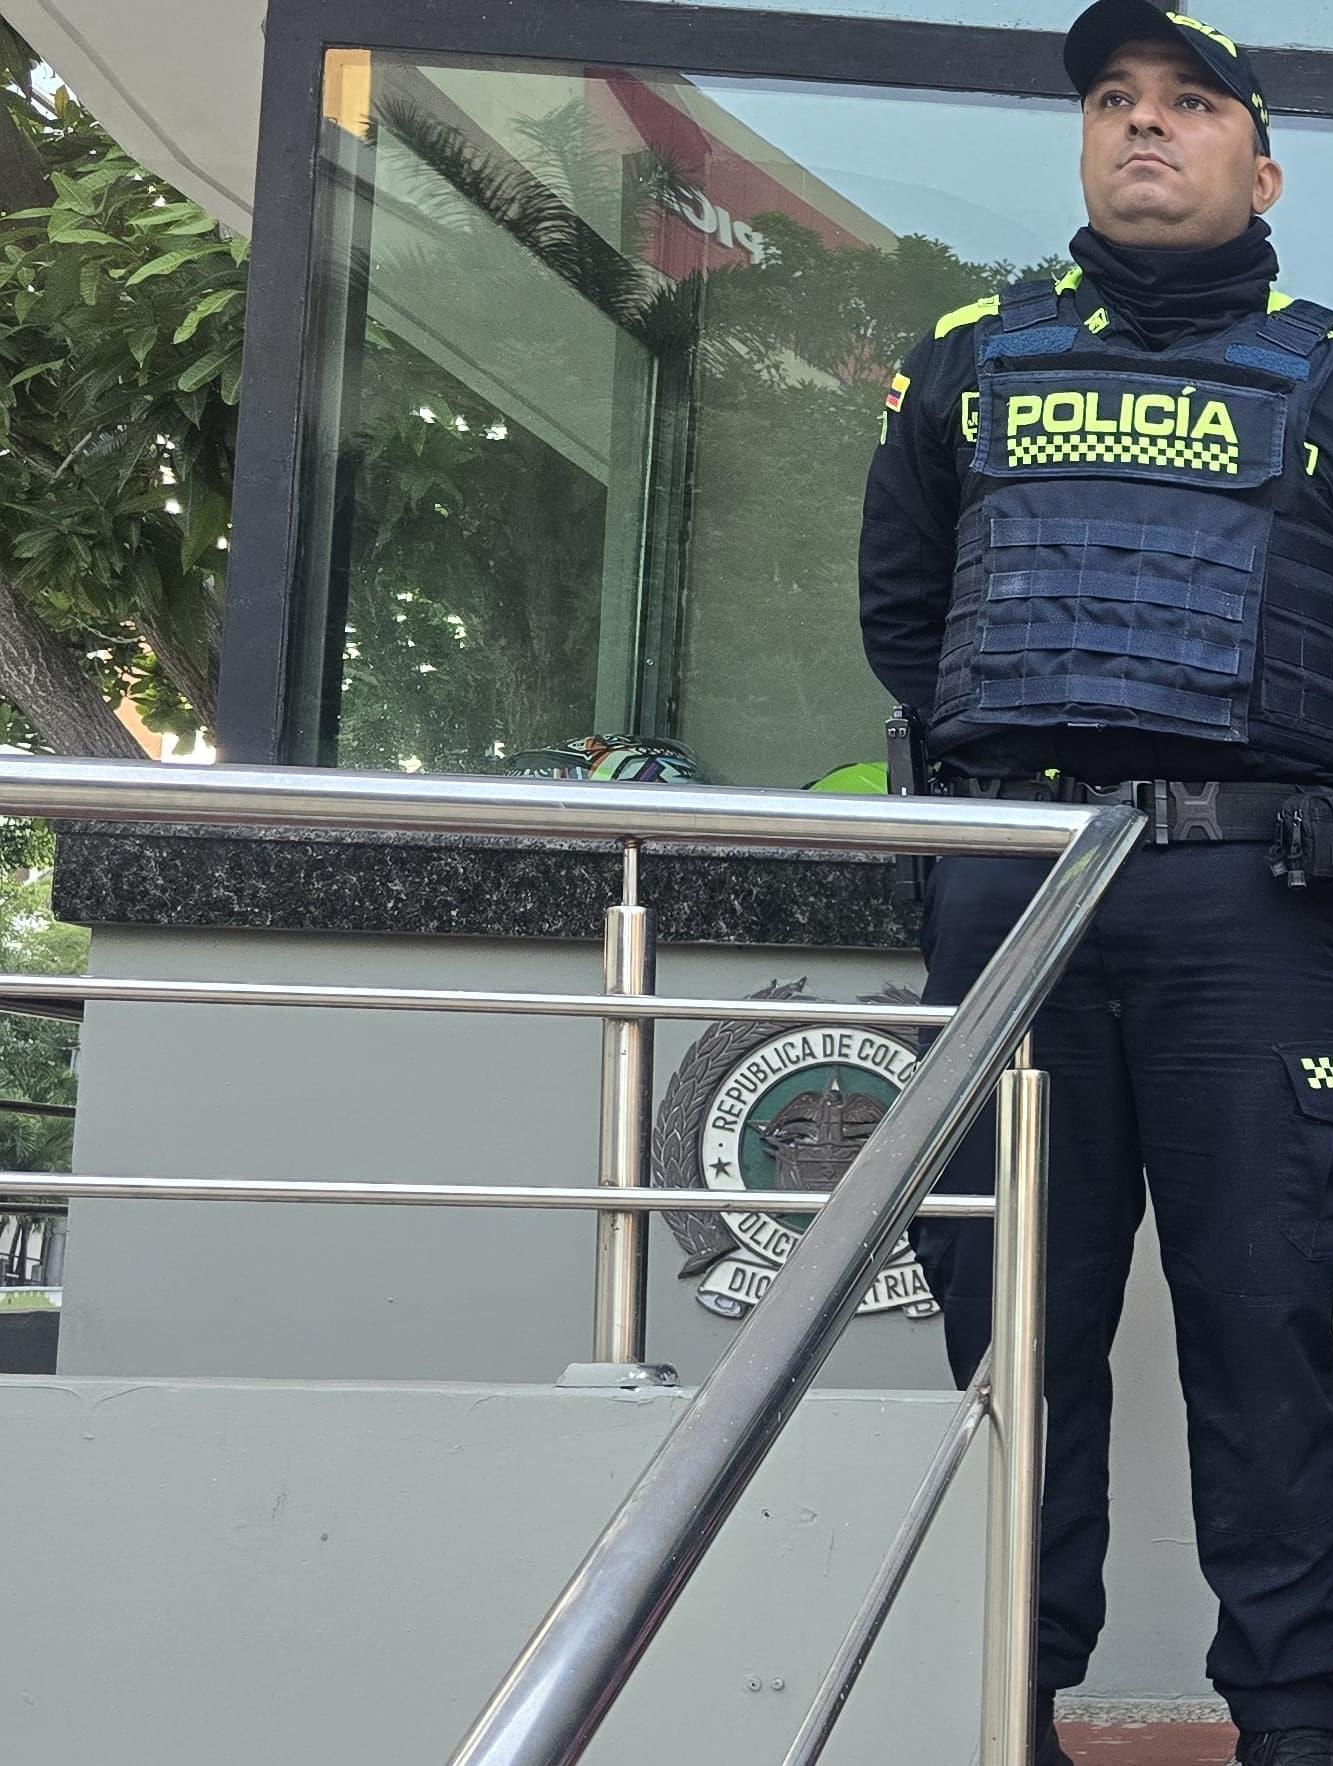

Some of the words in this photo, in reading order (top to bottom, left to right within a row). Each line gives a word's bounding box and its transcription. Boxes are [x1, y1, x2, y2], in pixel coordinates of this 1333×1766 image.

[1007, 382, 1239, 444] POLICÍA
[711, 1036, 817, 1134] REPUBLICA
[822, 1033, 852, 1059] DE
[857, 1037, 915, 1084] COLO
